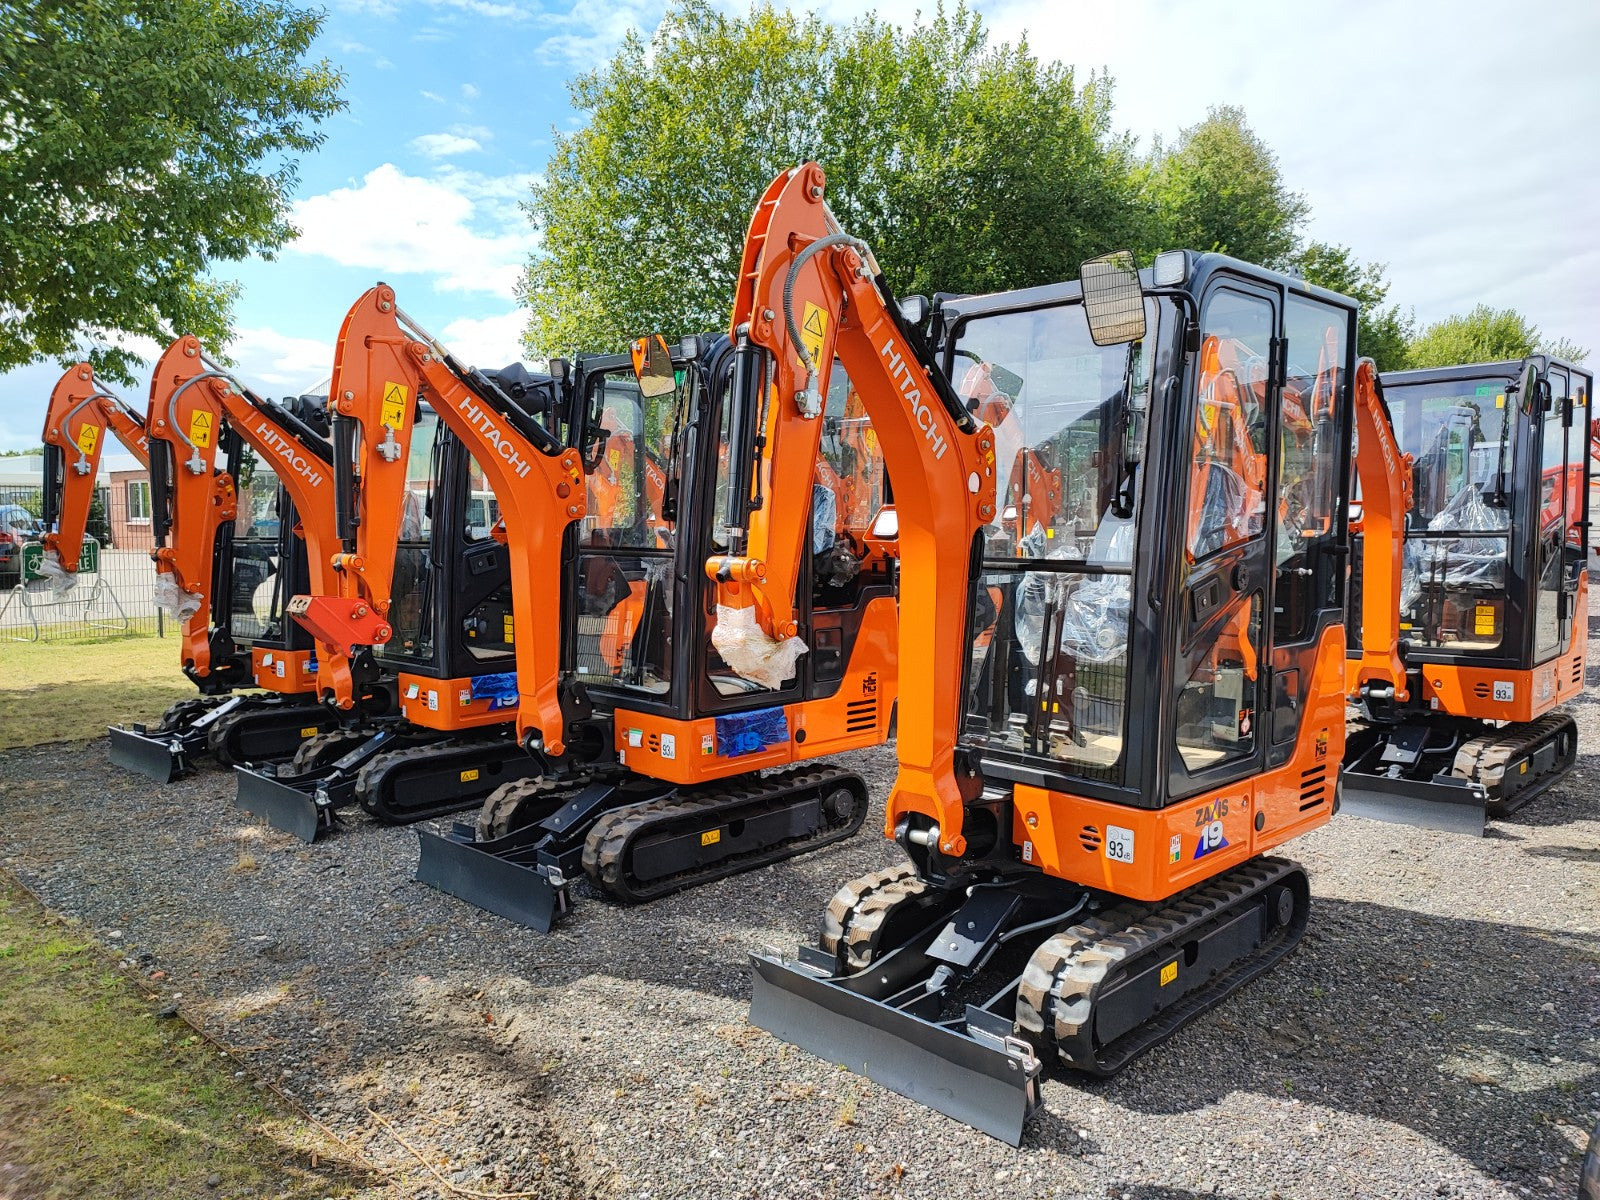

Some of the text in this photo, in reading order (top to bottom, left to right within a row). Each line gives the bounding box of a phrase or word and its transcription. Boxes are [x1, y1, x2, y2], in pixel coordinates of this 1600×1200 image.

[880, 338, 948, 460] HITACHI
[458, 396, 532, 479] HITACHI
[1373, 408, 1396, 475] HITACHI
[256, 422, 323, 488] HITACHI
[79, 557, 90, 571] LE
[80, 544, 90, 557] KE
[1495, 689, 1507, 700] 93
[662, 744, 671, 757] 93
[1196, 799, 1229, 827] ZAXIS
[1109, 840, 1124, 858] 93
[1201, 820, 1224, 851] 19
